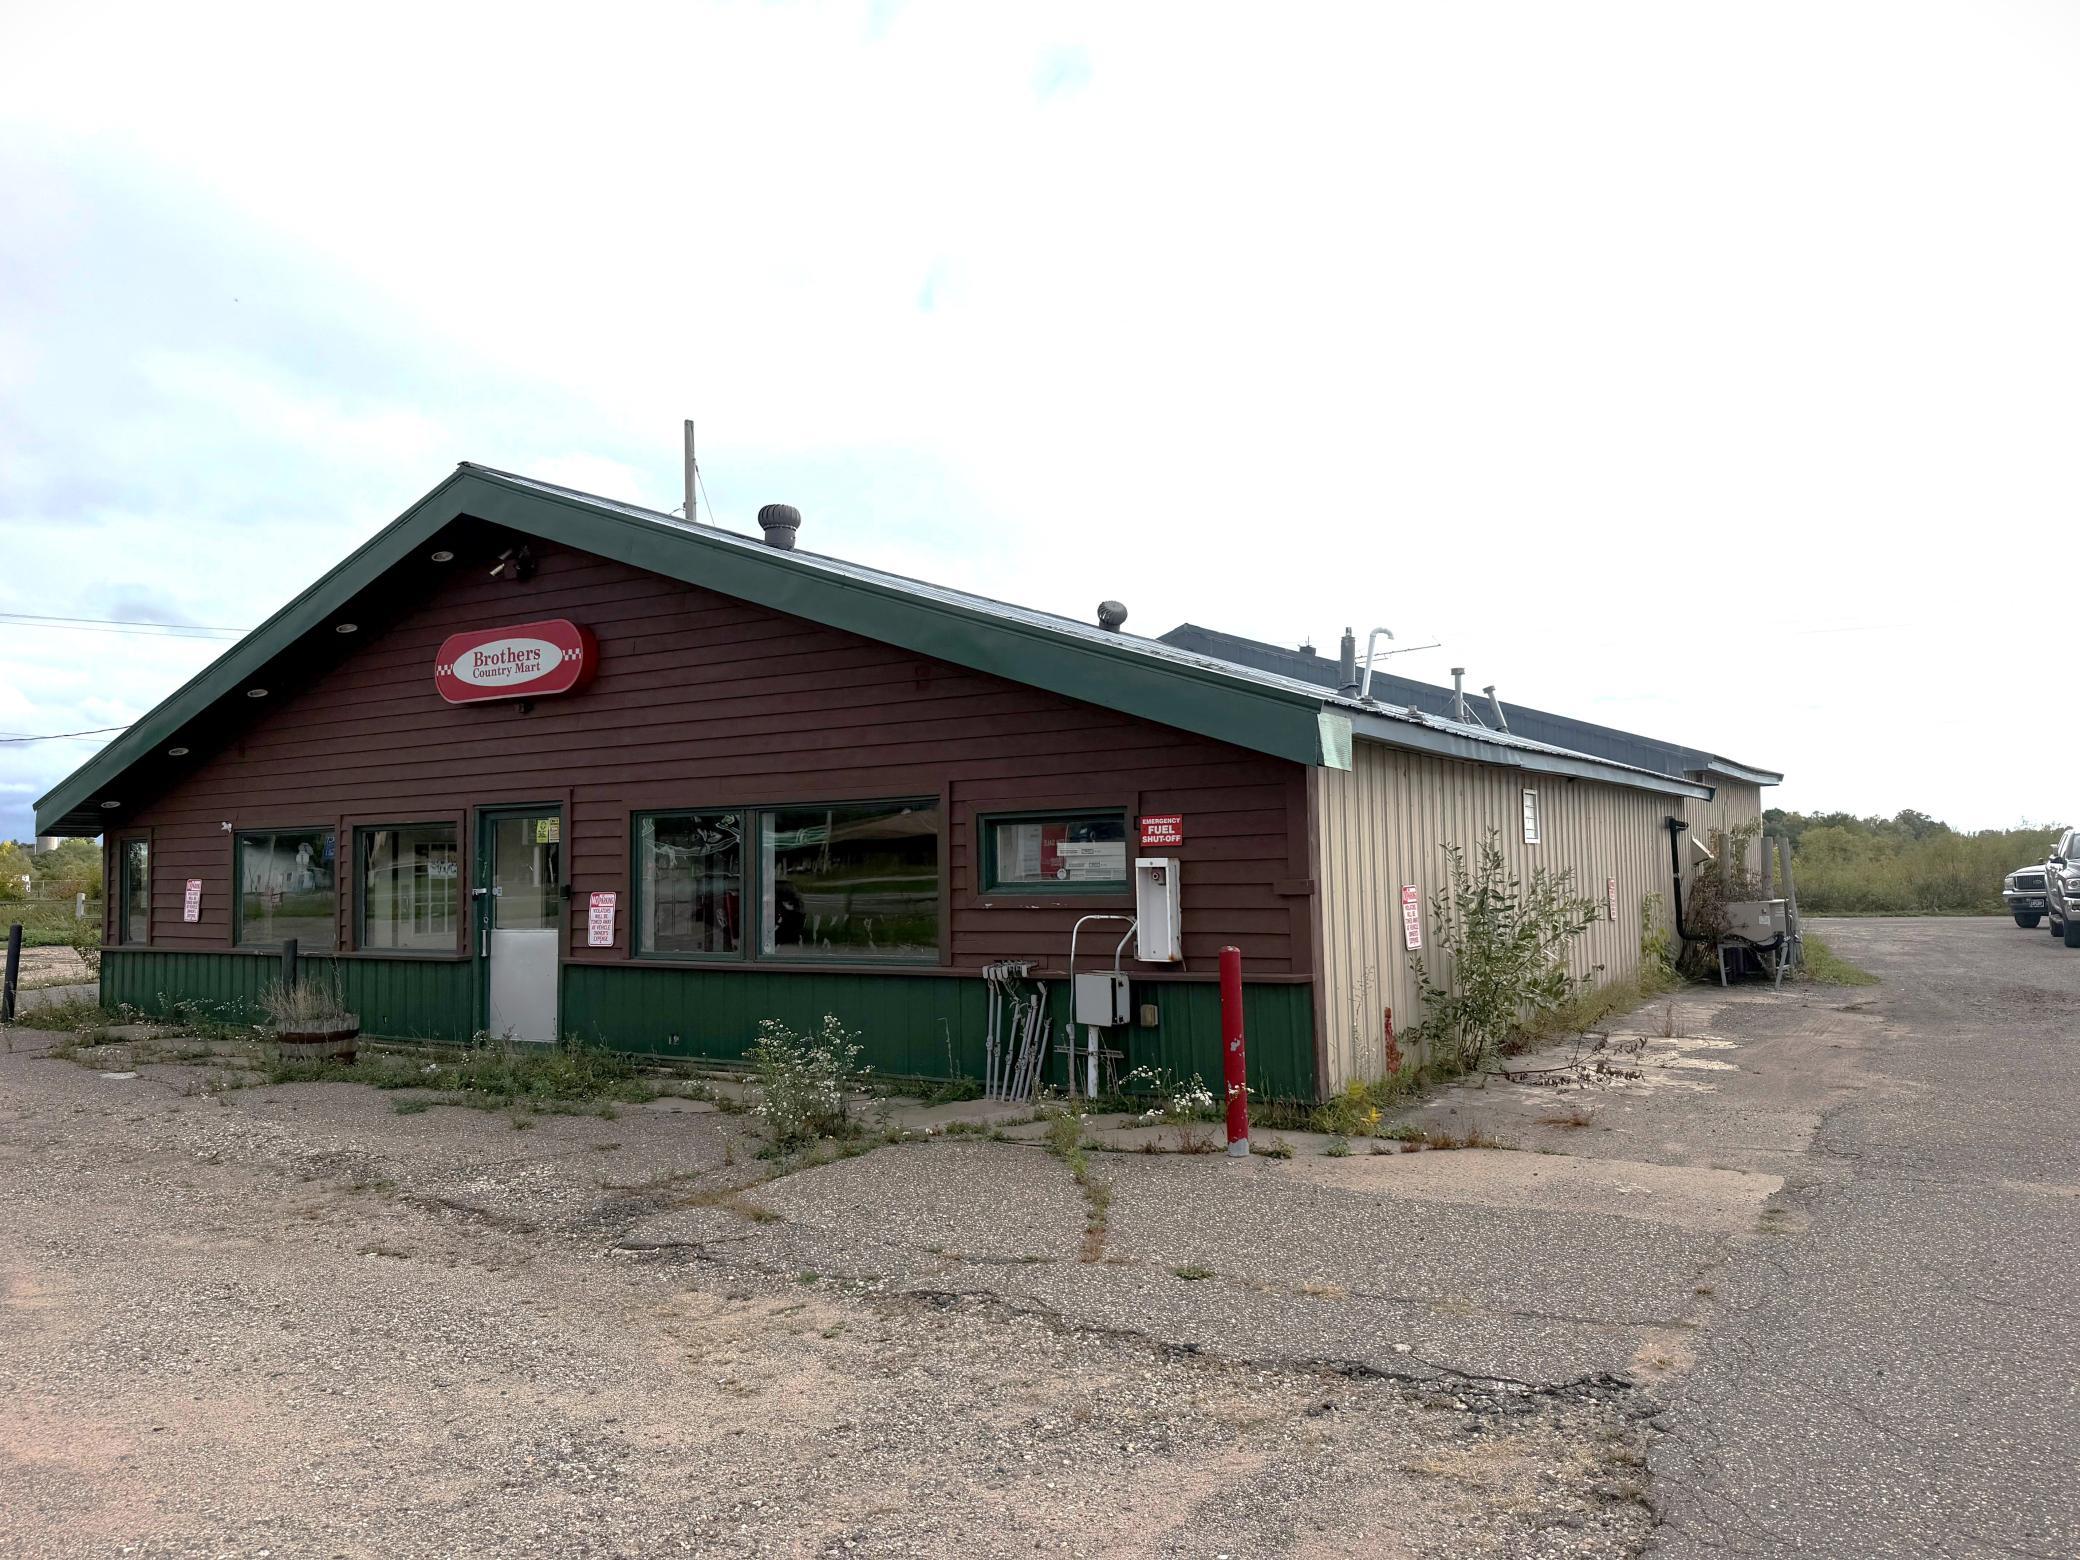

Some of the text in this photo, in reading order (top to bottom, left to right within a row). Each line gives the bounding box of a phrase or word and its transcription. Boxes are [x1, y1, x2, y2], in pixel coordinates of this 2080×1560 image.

[473, 647, 541, 667] Brothers
[473, 661, 540, 678] Country Mart
[1148, 825, 1175, 834] FUEL
[1142, 835, 1181, 843] SHUT-OFF
